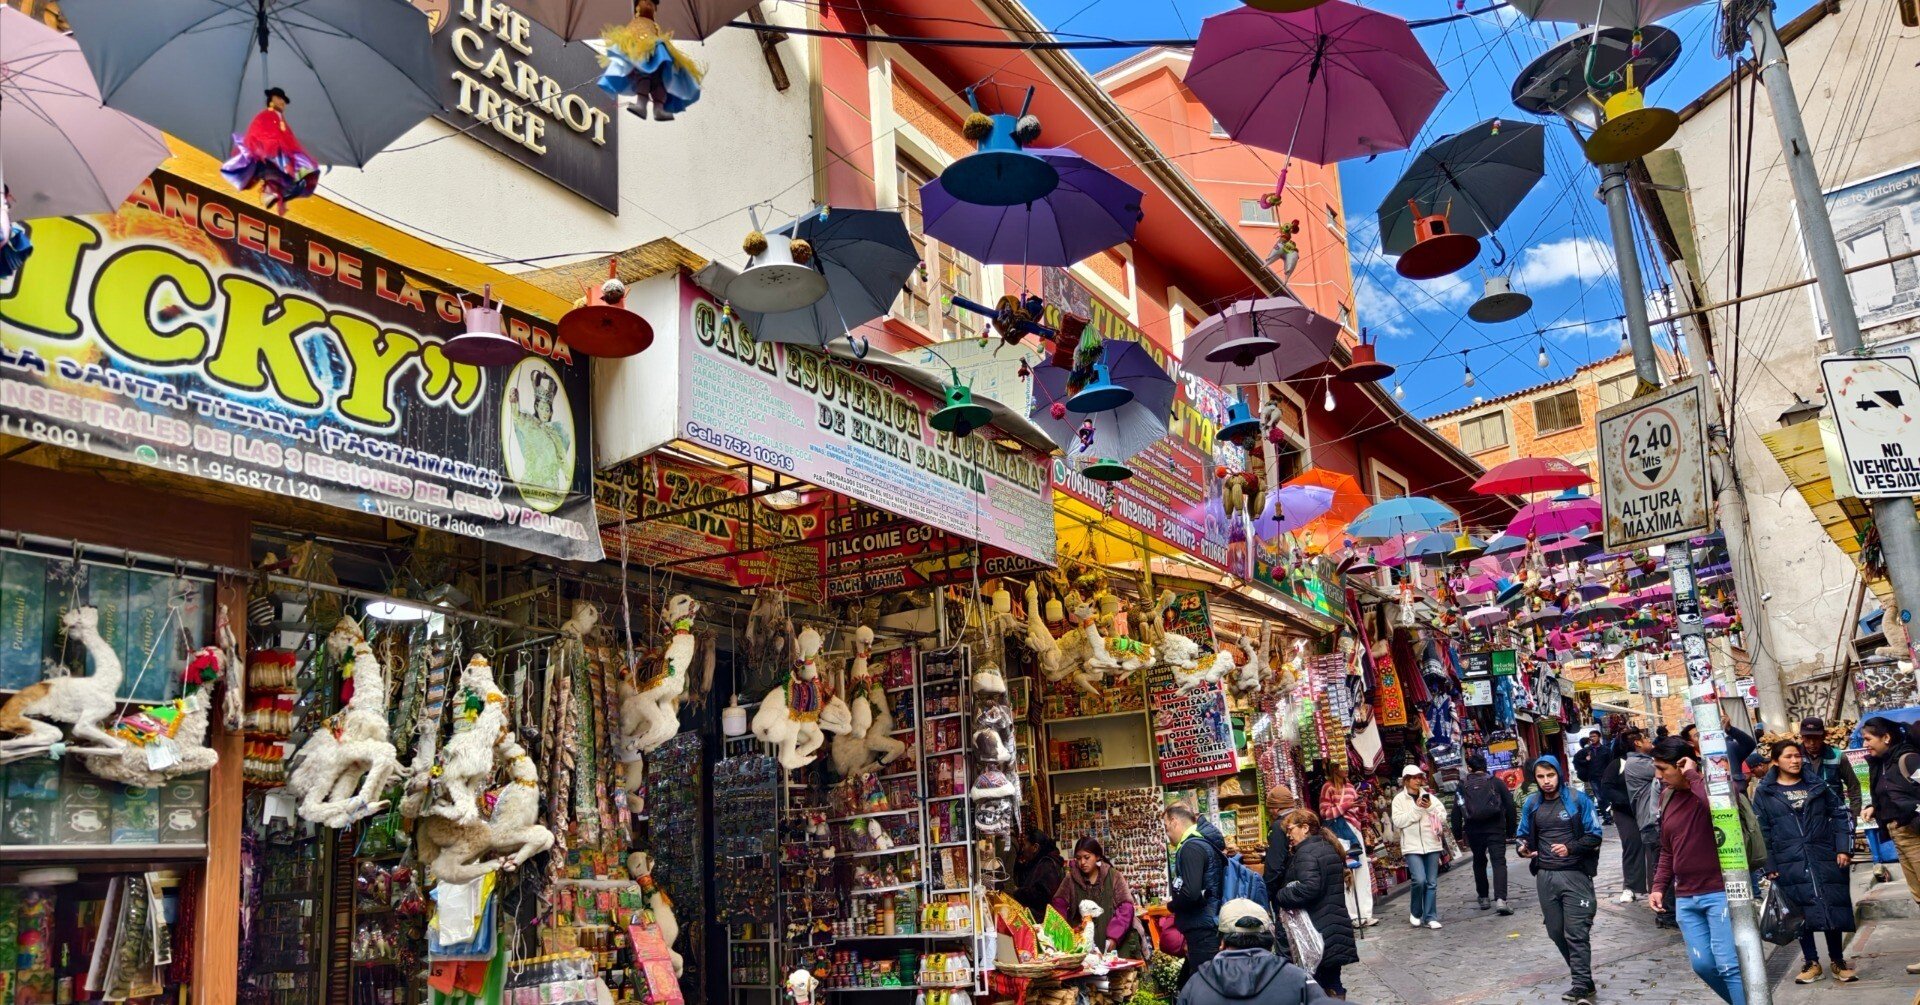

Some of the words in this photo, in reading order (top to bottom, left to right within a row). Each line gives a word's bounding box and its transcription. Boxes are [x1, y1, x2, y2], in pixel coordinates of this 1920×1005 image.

[460, 0, 533, 57] THE
[451, 27, 610, 146] CARROT
[451, 70, 547, 155] TREE
[1864, 180, 1909, 198] Witches
[124, 177, 294, 264] ANGEL
[308, 240, 362, 287] DE
[376, 266, 426, 313] LA
[695, 302, 778, 378] CASA
[692, 353, 738, 380] PRODUCTOS
[740, 372, 751, 384] DE
[692, 376, 722, 395] HARINA
[724, 387, 735, 400] DE
[759, 401, 777, 417] MATE
[788, 413, 806, 430] COCA
[692, 387, 735, 411] UNGUENTO
[737, 403, 747, 416] DE
[749, 407, 768, 424] COCA
[692, 398, 716, 415] LICOR
[718, 407, 728, 420] DE
[730, 411, 750, 428] COCA
[57, 356, 188, 411] SANTA
[188, 390, 315, 443] TIERRA
[319, 425, 503, 498] (PACHAMAMA)
[692, 410, 722, 430] ENERGY
[748, 430, 783, 451] CAPSULAS
[784, 442, 794, 455] DE
[795, 446, 814, 462] COCA
[1628, 423, 1672, 459] 2.40
[724, 434, 752, 457] 752
[754, 447, 795, 471] 10919
[818, 401, 846, 437] DE
[850, 414, 911, 465] ELENA
[915, 445, 986, 495] SARAVIA
[1642, 455, 1662, 469] Mts
[1881, 442, 1904, 458] NO
[161, 453, 322, 501] +51-956877120
[826, 470, 856, 487] PREPARADOS
[1853, 457, 1920, 475] VEHICUL
[194, 424, 232, 457] DE
[233, 434, 283, 468] LAS
[284, 447, 303, 473] 3
[304, 452, 413, 500] REGIONES
[414, 479, 453, 509] DEL
[504, 504, 520, 525] Y
[519, 507, 589, 541] BOLIVIA
[376, 498, 440, 528] Victoria
[444, 514, 485, 538] Janco
[1621, 488, 1682, 519] ALTURA
[1181, 597, 1200, 611] #3
[12, 597, 25, 651] Patchouli
[1162, 697, 1208, 711] EMPRESAS
[1172, 708, 1201, 719] AUTOS
[1169, 727, 1211, 739] OFICINAS
[1173, 718, 1203, 728] MINAS
[1163, 749, 1189, 760] LLAMA
[1192, 743, 1227, 755] CLIENTES
[1173, 737, 1210, 749] BANCOS
[1164, 760, 1191, 770] LLAMA
[1192, 753, 1230, 765] FORTUNA
[1165, 767, 1199, 779] CURACIONES
[1199, 766, 1214, 774] PARA
[1214, 762, 1233, 772] ANIMO
